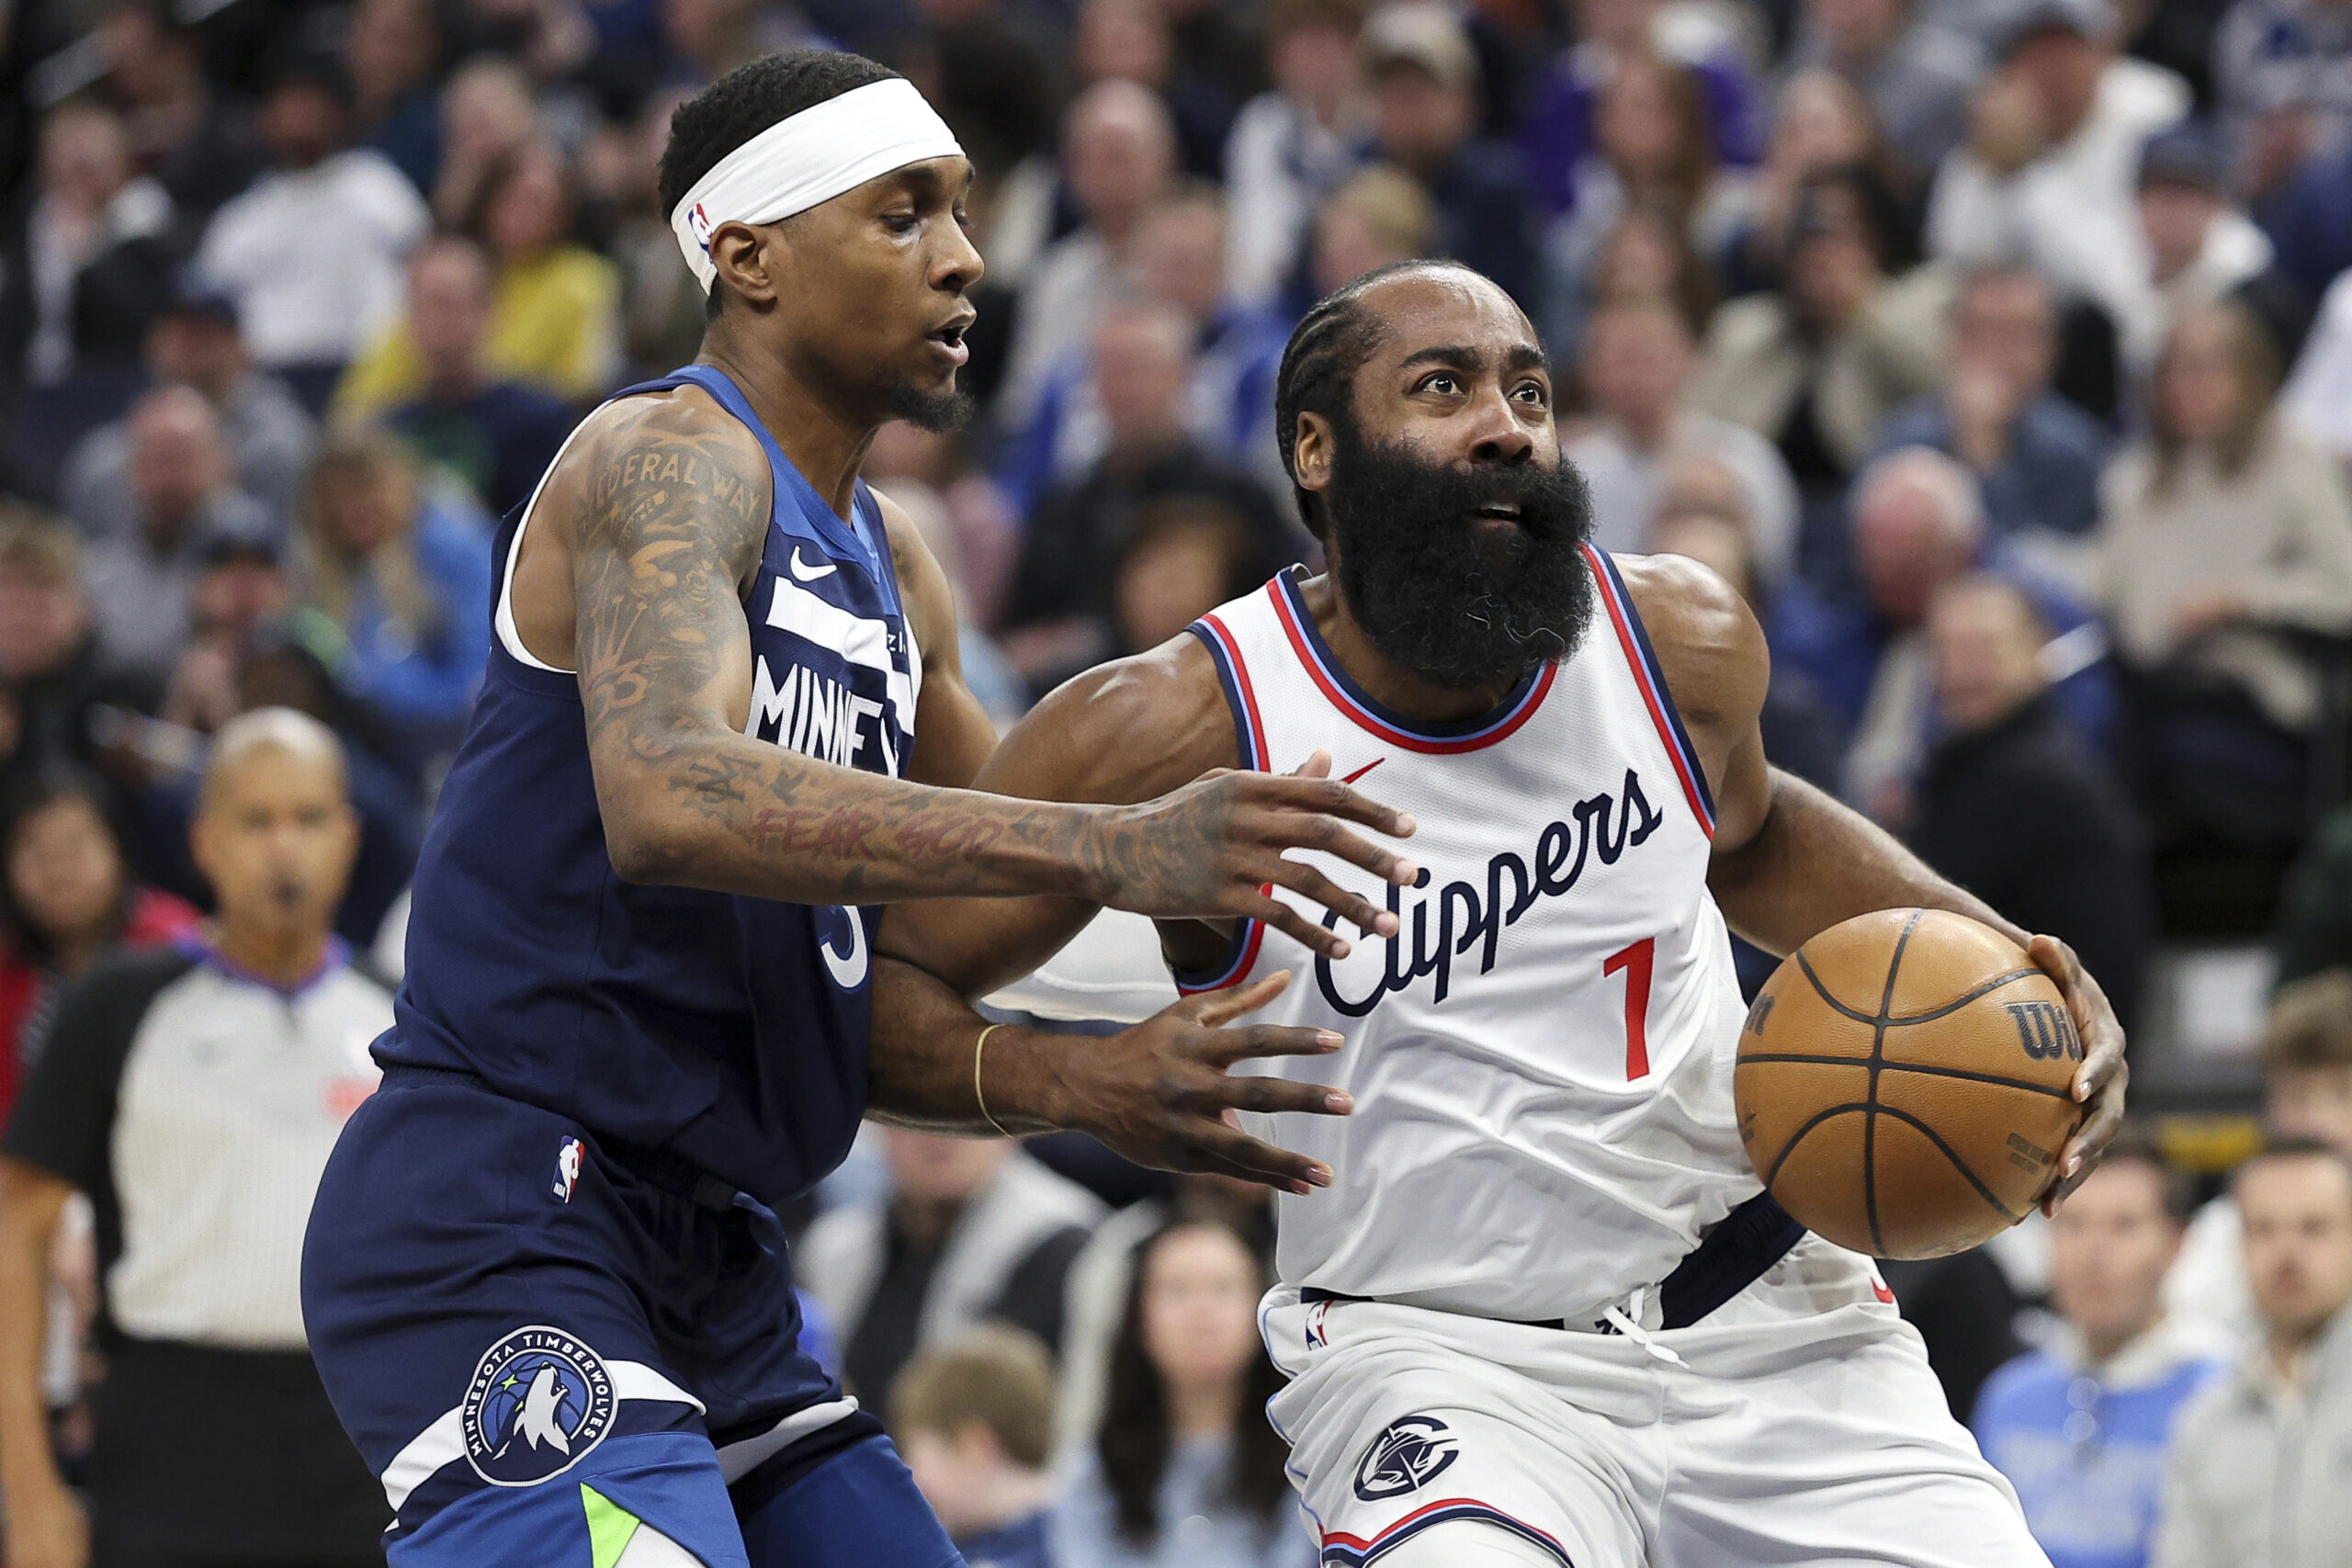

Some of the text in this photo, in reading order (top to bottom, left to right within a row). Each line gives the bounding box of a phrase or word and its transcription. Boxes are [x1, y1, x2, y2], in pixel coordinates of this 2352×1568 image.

[712, 465, 762, 522] WAY
[752, 803, 1005, 862] FEAR GOD
[1314, 767, 1664, 1018] Clippers
[1603, 935, 1656, 1082] 1
[465, 1334, 610, 1457] MINNESOTA TIMBERWOLVES
